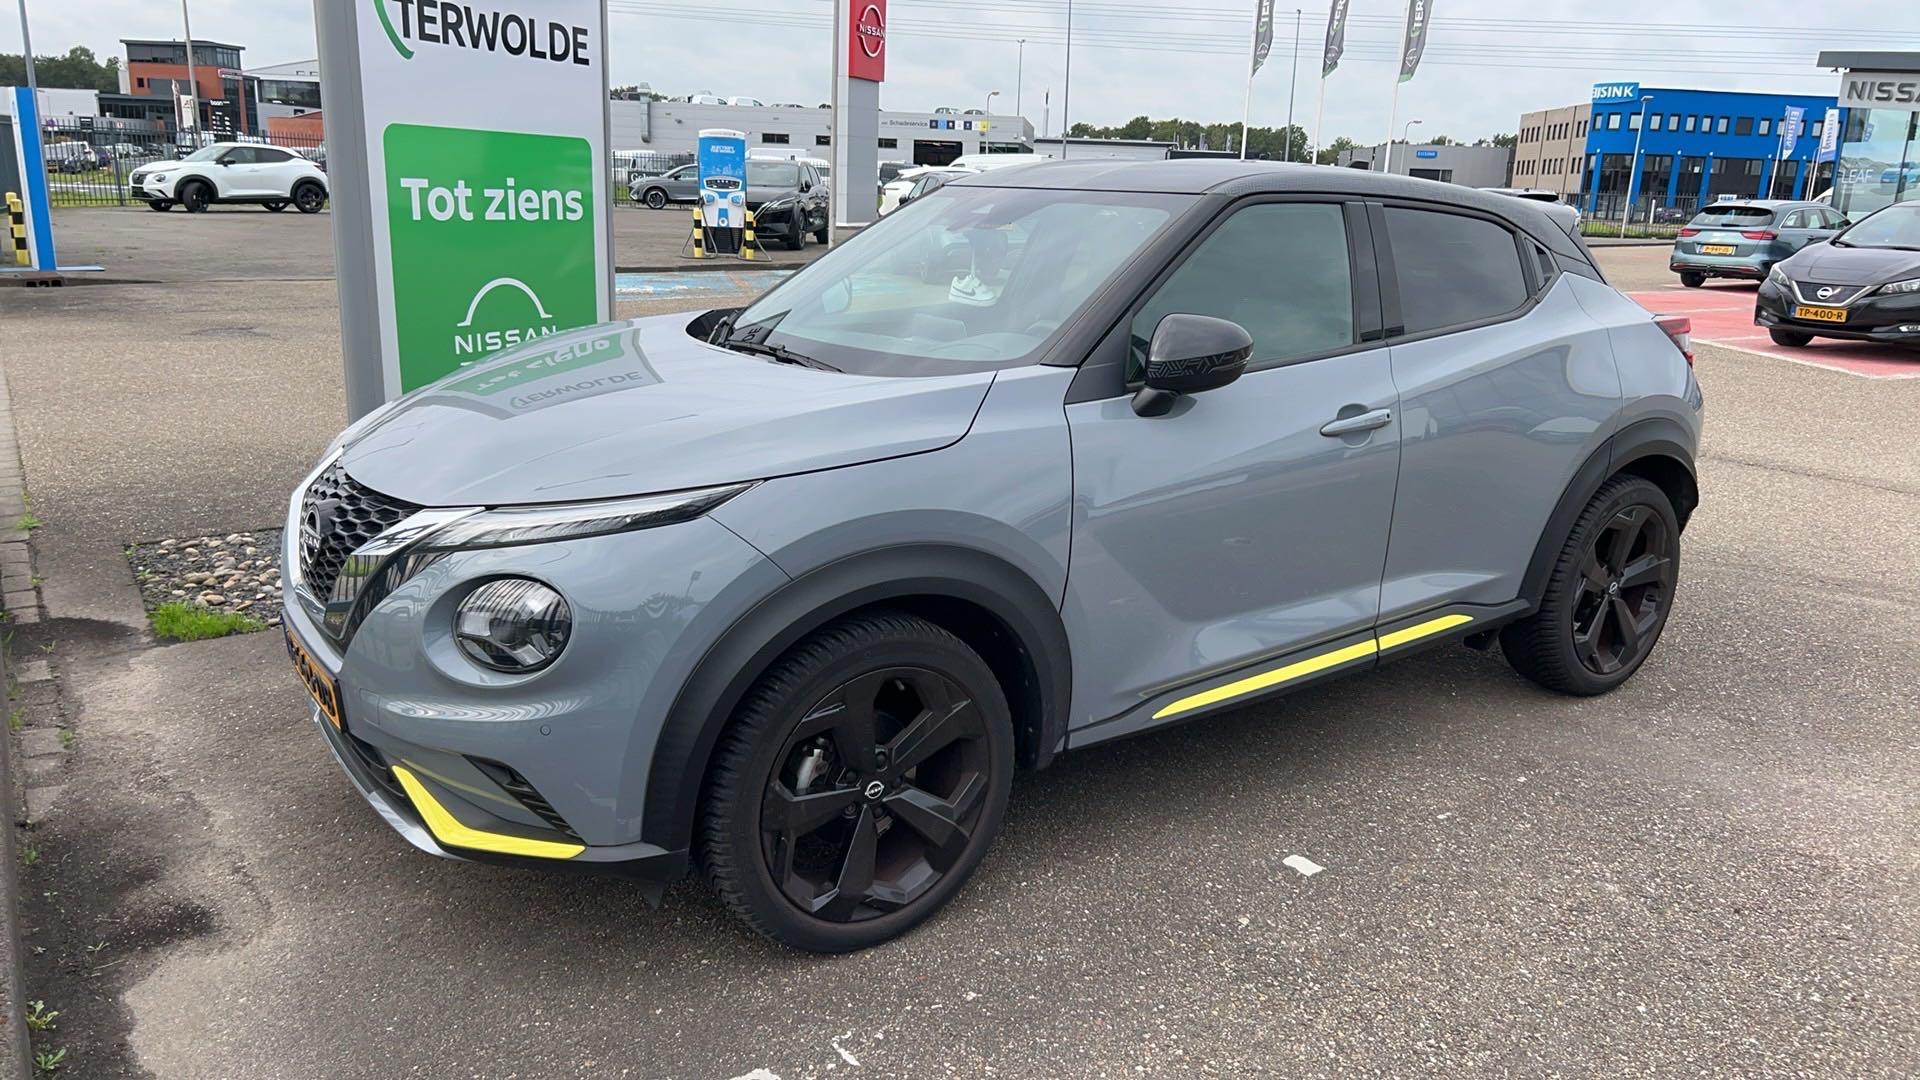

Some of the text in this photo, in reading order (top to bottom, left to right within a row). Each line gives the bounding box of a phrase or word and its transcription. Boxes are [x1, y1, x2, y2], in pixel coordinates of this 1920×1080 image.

[392, 0, 590, 66] TERWOLDE
[860, 23, 887, 38] NISSAN
[1847, 80, 1920, 103] NISS
[1841, 168, 1873, 184] LEAF
[400, 177, 584, 221] Tot ziens
[1799, 308, 1844, 320] TP-400-R
